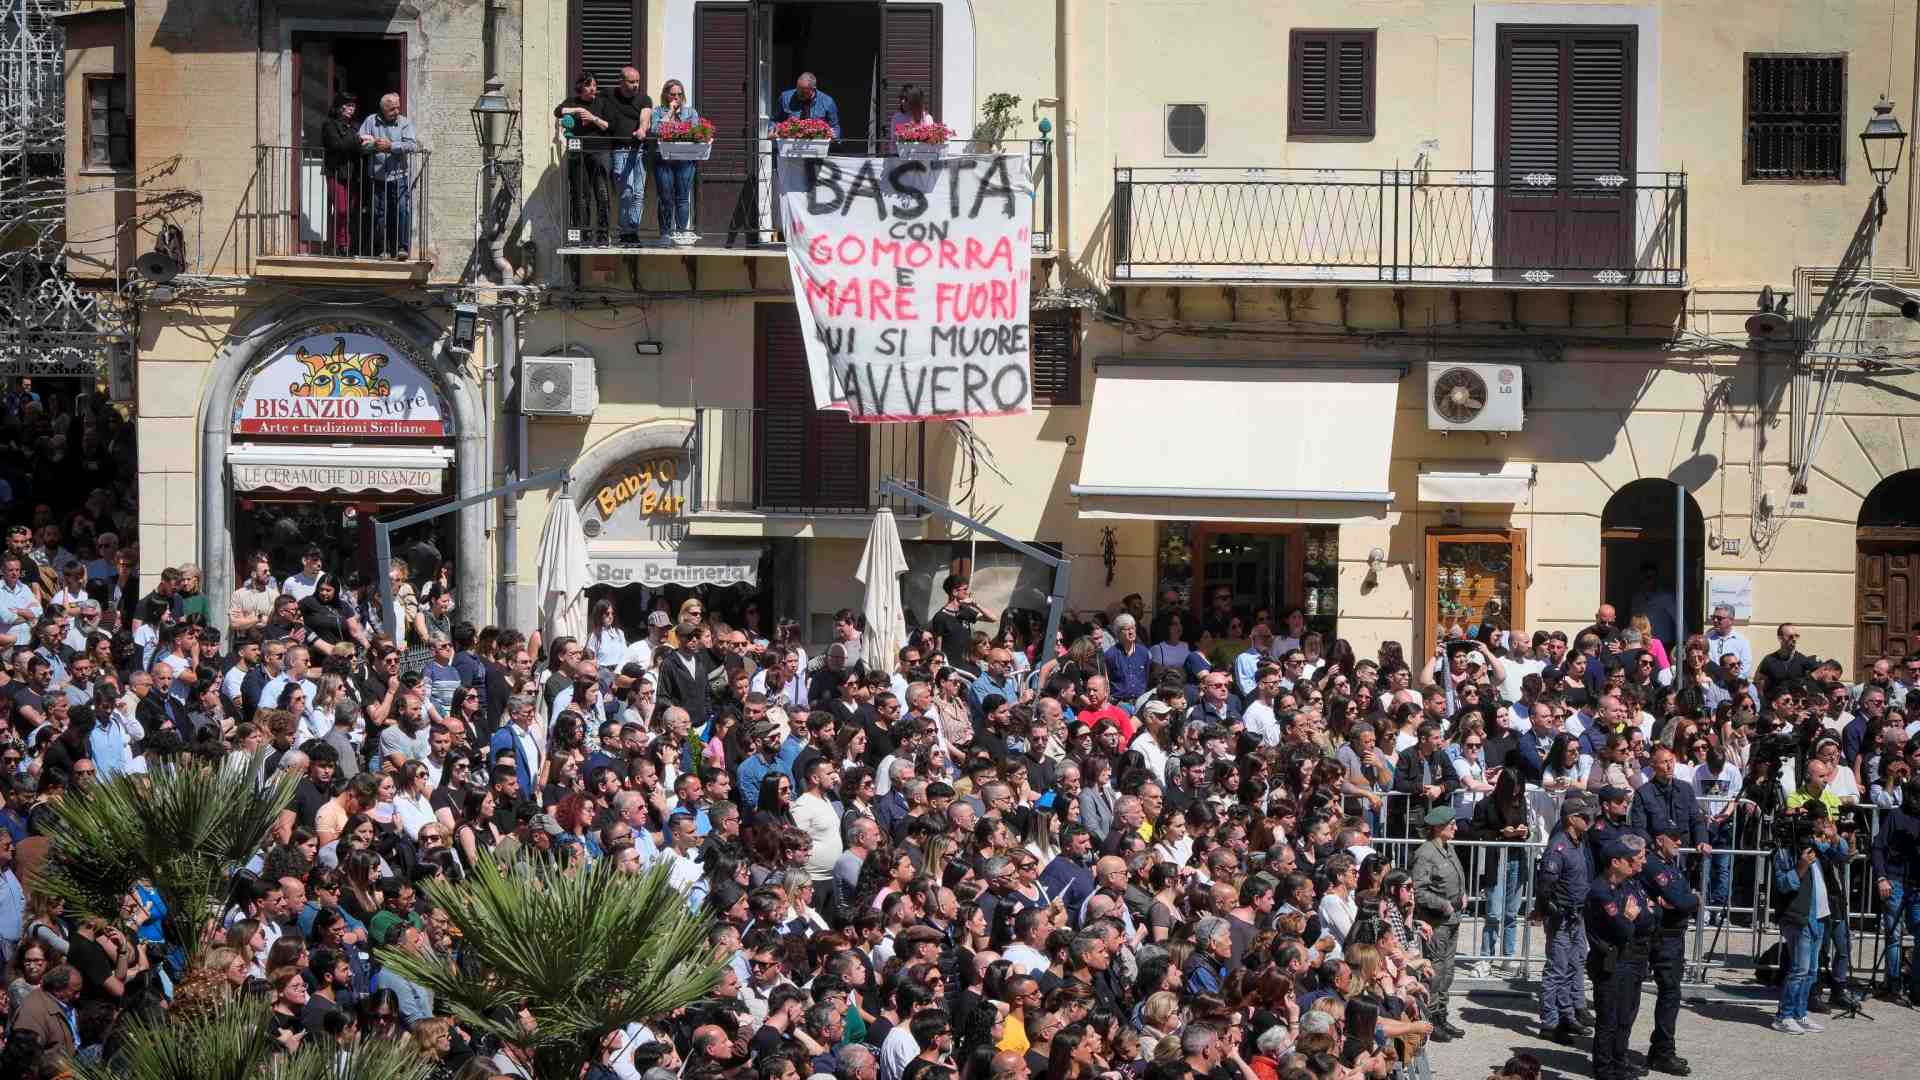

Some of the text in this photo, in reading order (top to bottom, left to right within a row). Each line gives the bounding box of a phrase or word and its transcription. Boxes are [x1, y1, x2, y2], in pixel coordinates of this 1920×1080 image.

[803, 156, 1016, 220] BASTA
[889, 220, 949, 241] CON
[896, 267, 914, 287] E
[815, 324, 1029, 357] UI SI MUORE
[255, 392, 425, 418] BISANZIO Store
[258, 421, 426, 434] Arte e tradizioni Siciliane
[244, 468, 432, 486] LE CERAMICHE DI BISANZIO
[641, 491, 686, 514] Bar
[596, 563, 745, 581] Bar Panineria
